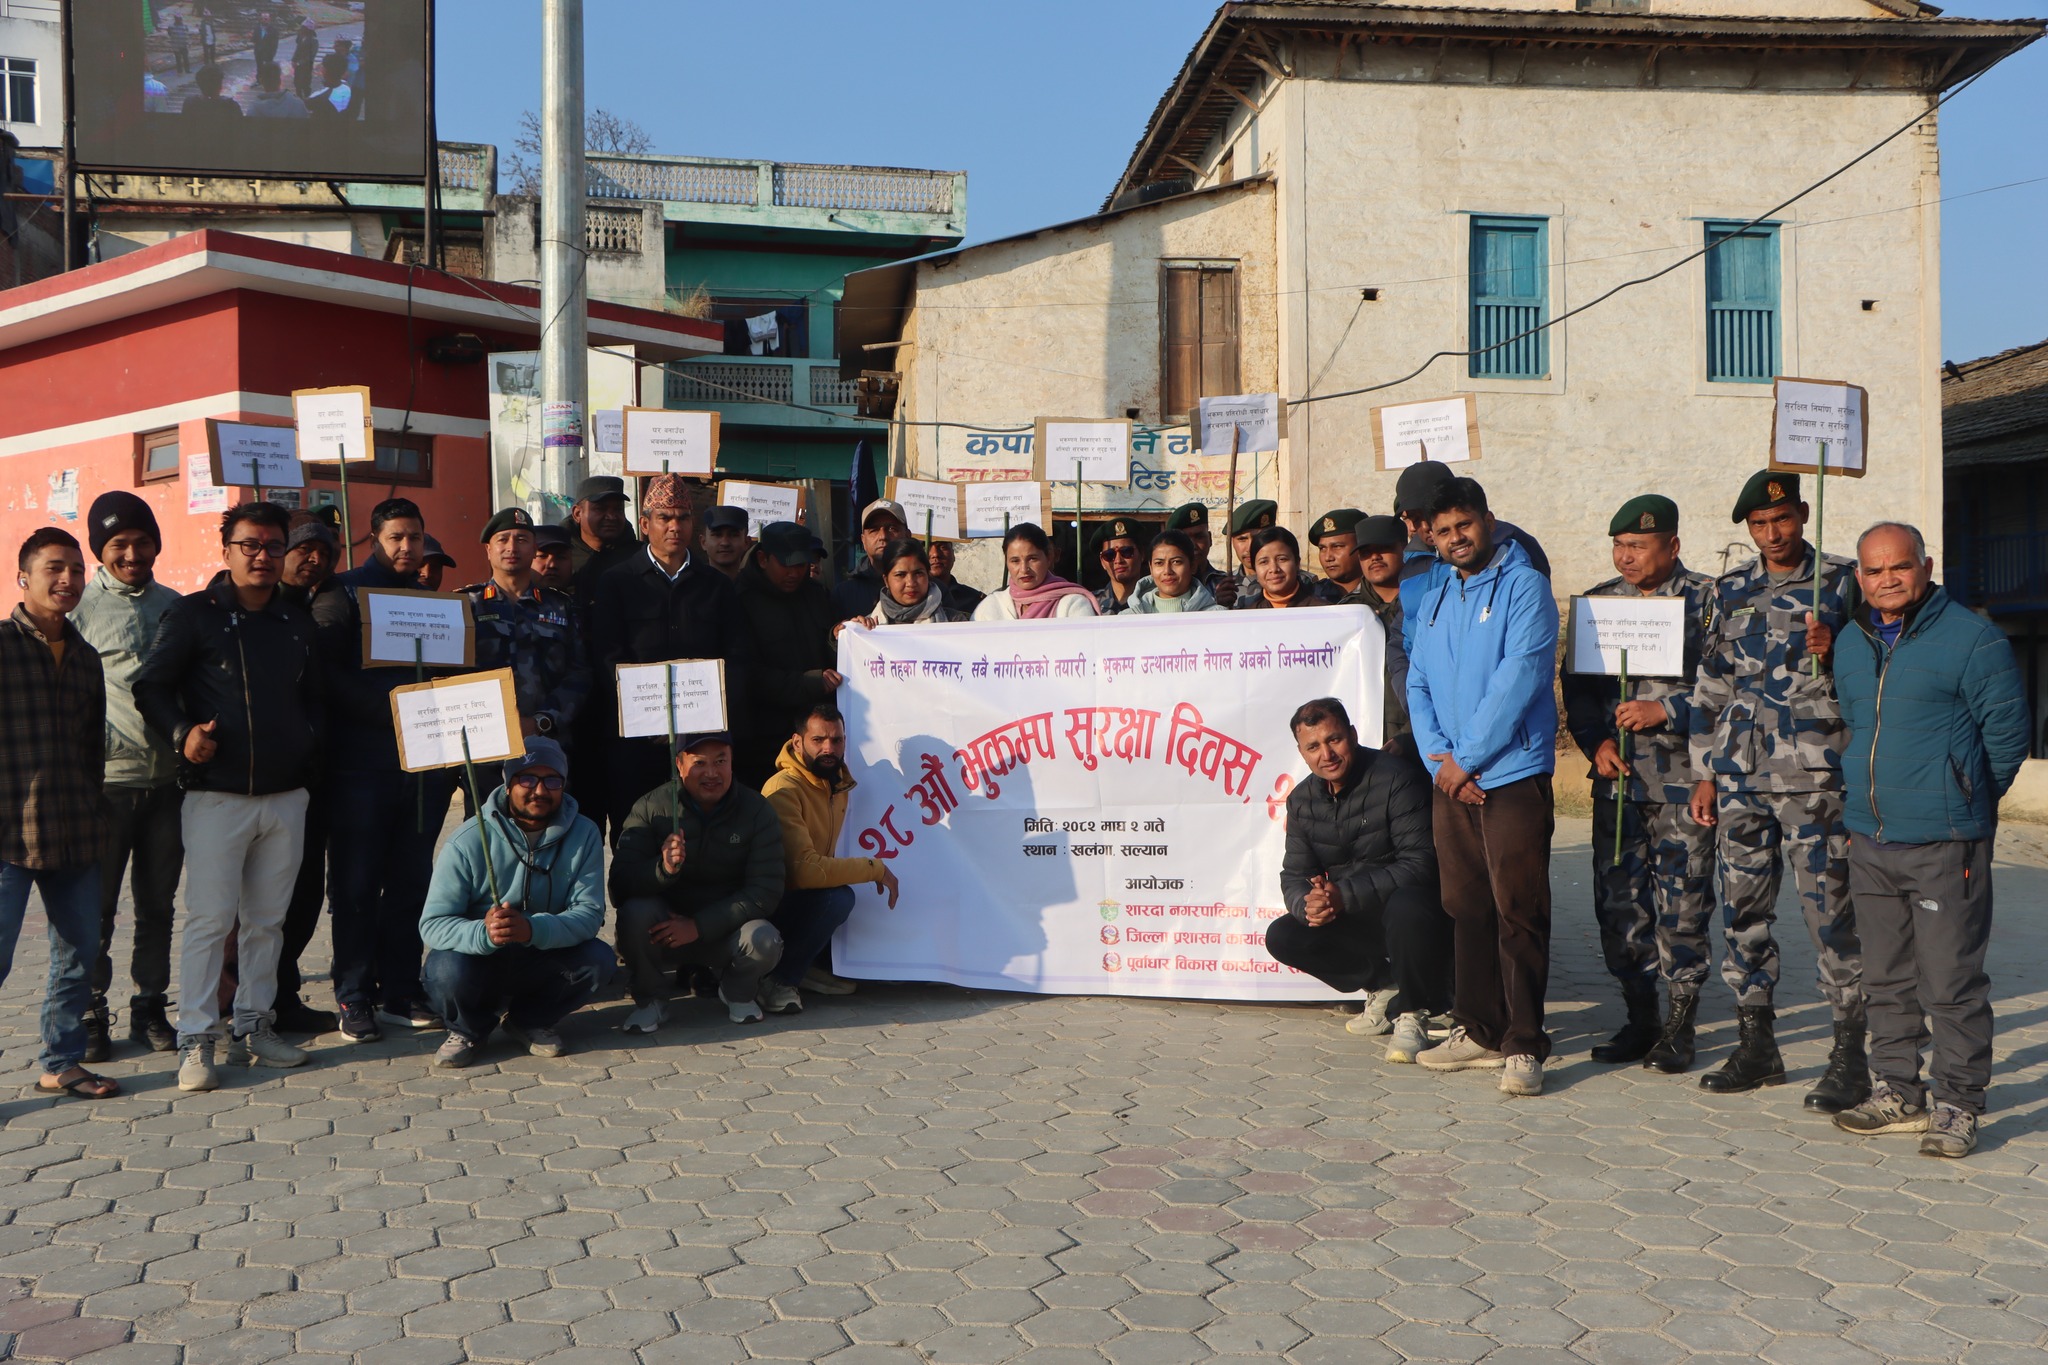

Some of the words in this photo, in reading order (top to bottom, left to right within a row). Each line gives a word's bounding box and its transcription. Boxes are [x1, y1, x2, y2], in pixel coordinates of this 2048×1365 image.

[1785, 401, 1808, 413] सुरक्षित
[1820, 421, 1826, 429] र
[965, 433, 1035, 456] कपा
[1788, 434, 1811, 444] व्यवहार
[1616, 618, 1637, 627] जोखिम
[1612, 630, 1635, 641] सुरक्षित
[1594, 642, 1622, 651] निर्माणमा
[890, 660, 917, 682] तहका
[922, 660, 963, 682] सरकार,
[971, 654, 989, 679] सबै
[993, 653, 1050, 680] नागरिकको
[1054, 651, 1087, 679] तयारी
[1103, 656, 1136, 684] भुकम्प
[1141, 647, 1199, 675] उत्थानशील
[1203, 648, 1233, 672] नेपाल
[1239, 645, 1272, 670] अबको
[683, 690, 709, 698] निर्माणमा
[448, 716, 464, 724] नेपाल
[467, 712, 493, 722] निर्माणमा
[858, 804, 914, 859] २८
[953, 711, 1056, 800] भुकम्प
[1064, 706, 1161, 772] सुरक्षा
[1165, 702, 1263, 804] दिवस,
[1062, 821, 1096, 832] २०८२
[1101, 820, 1126, 832] माघ
[1131, 821, 1139, 832] २
[1144, 817, 1166, 832] गते
[1022, 844, 1057, 857] स्थान
[1120, 844, 1168, 857] सल्यान
[1125, 875, 1184, 890] आयोजक
[1126, 904, 1165, 917] शारदा
[1126, 927, 1169, 944] जिल्ला
[1173, 932, 1221, 945] प्रशासन
[1127, 954, 1171, 973] पूर्वाधार
[1175, 955, 1218, 972] विकास
